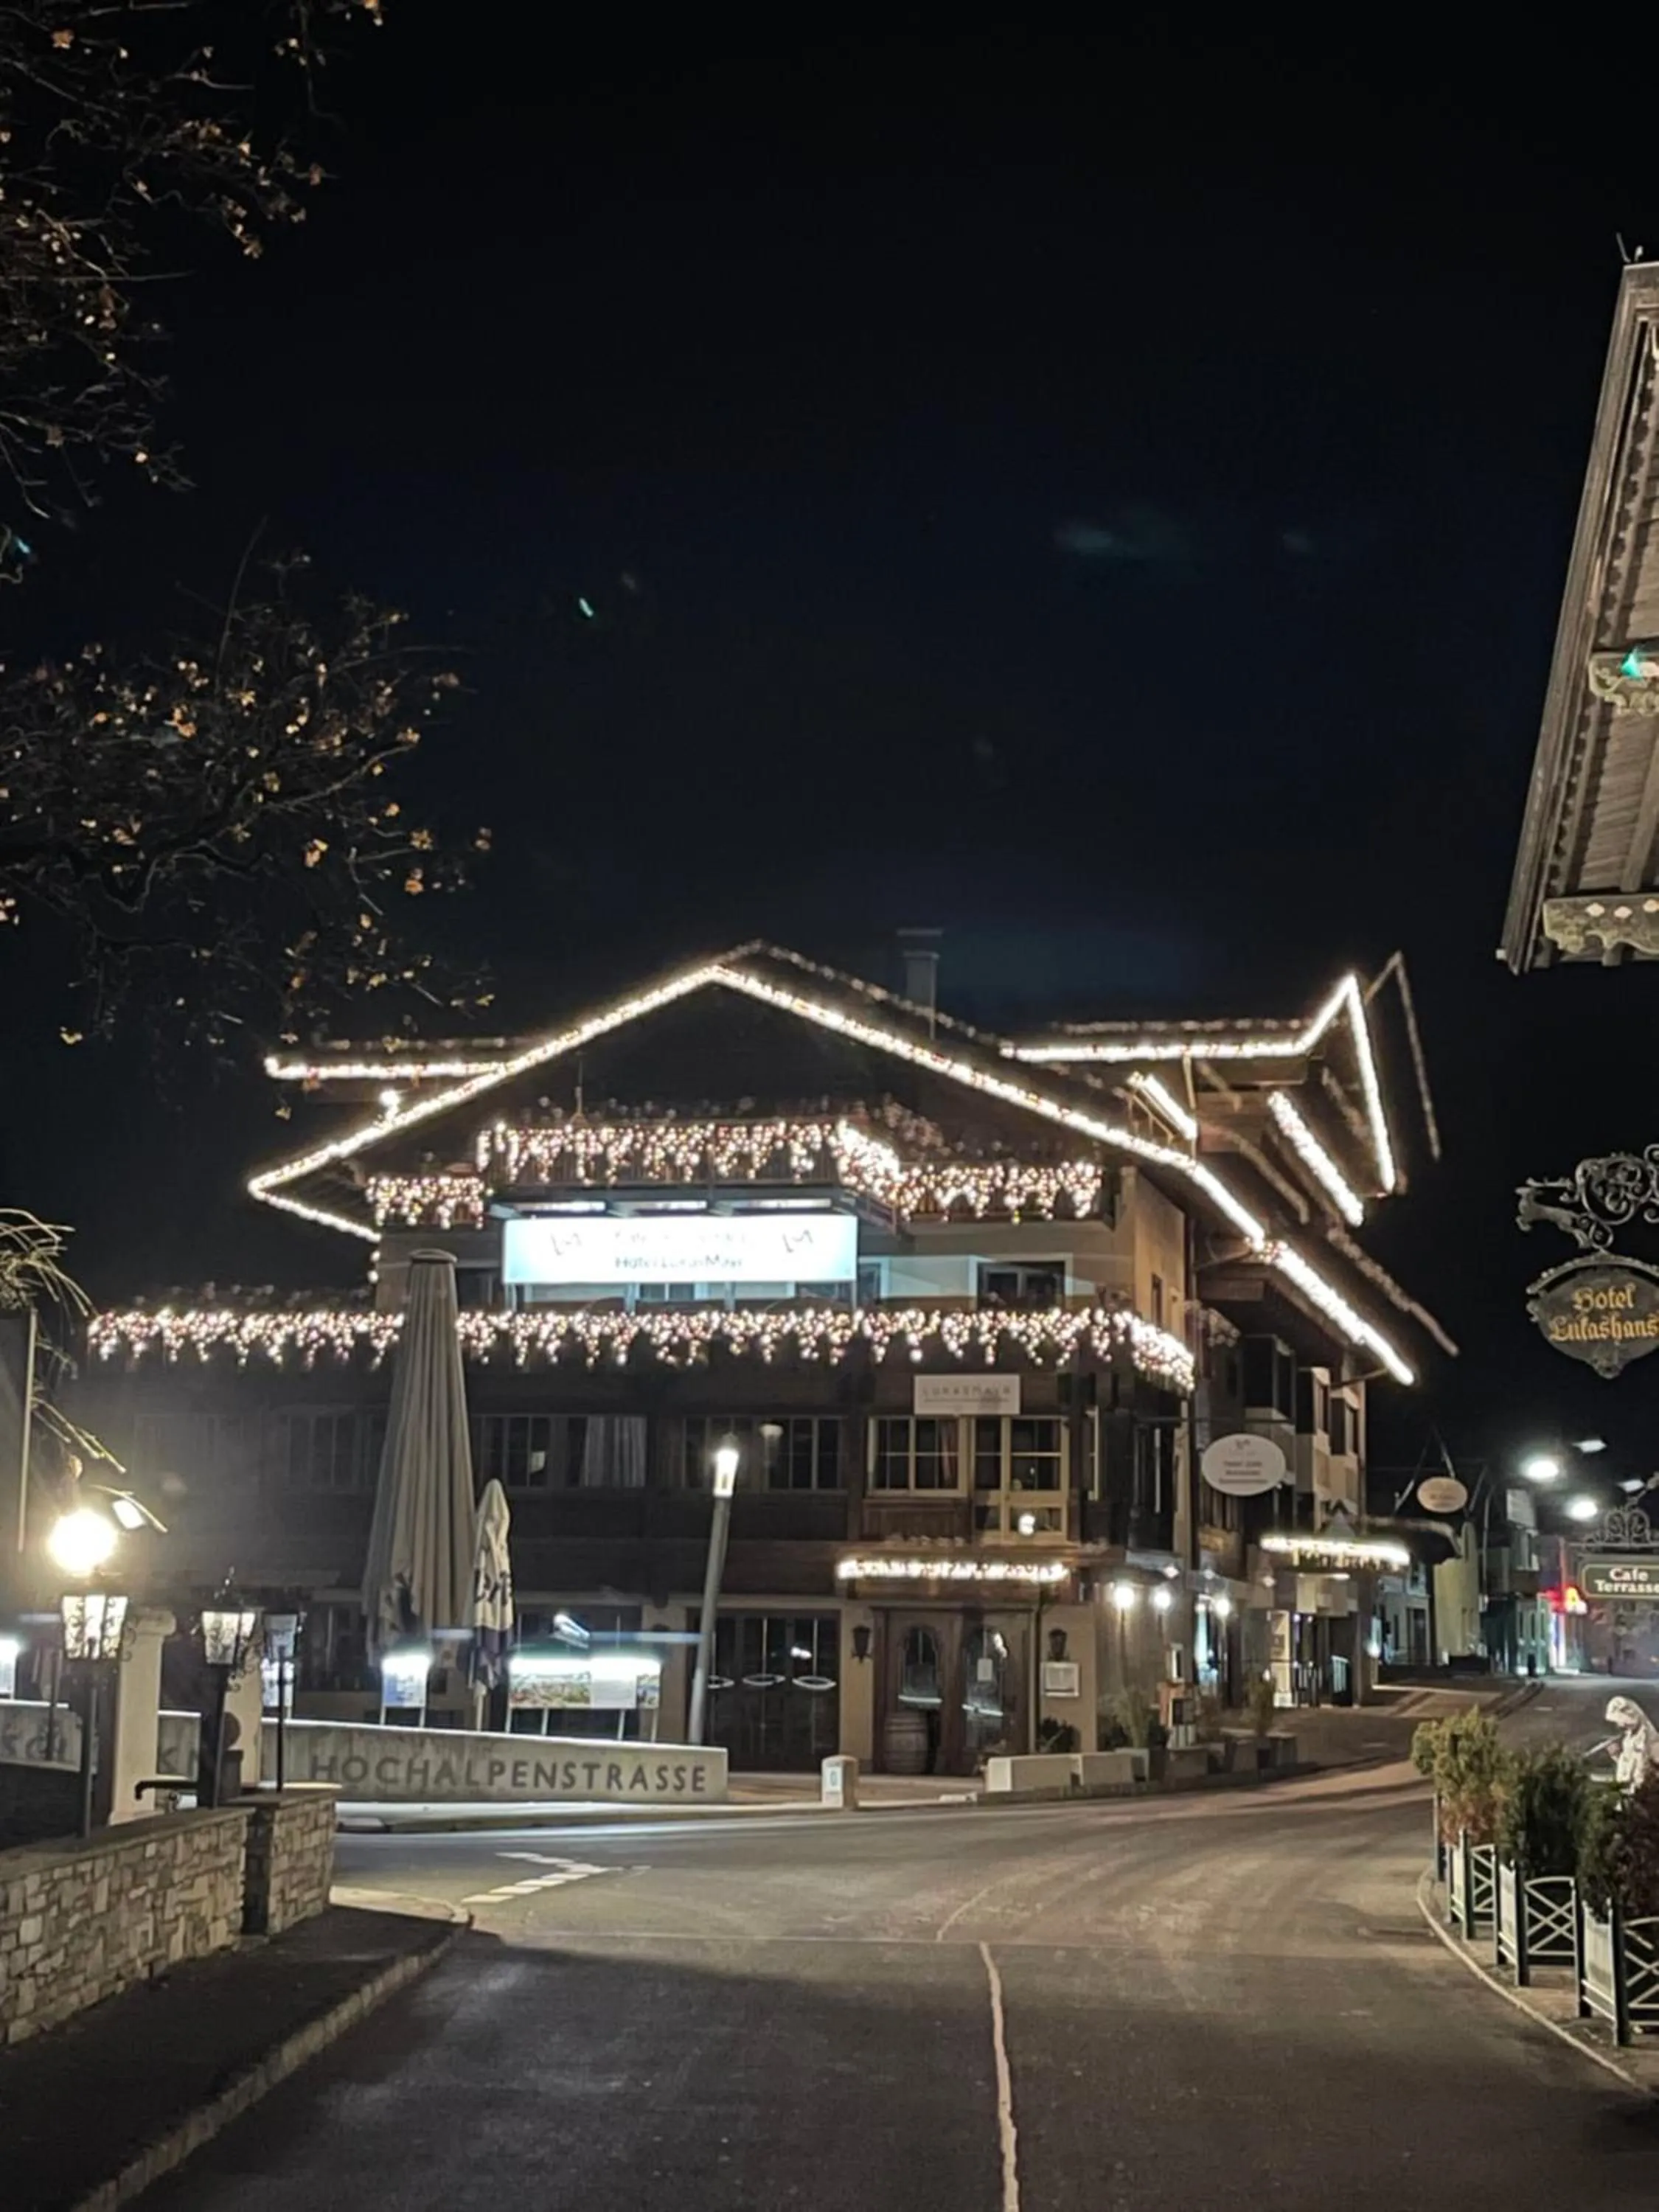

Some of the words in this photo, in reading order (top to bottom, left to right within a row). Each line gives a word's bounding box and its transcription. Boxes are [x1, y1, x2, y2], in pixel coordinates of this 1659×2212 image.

[1572, 1282, 1636, 1312] Hotel
[1549, 1312, 1659, 1343] Lukashans
[310, 1754, 707, 1792] HOCHALPENSTRASSE
